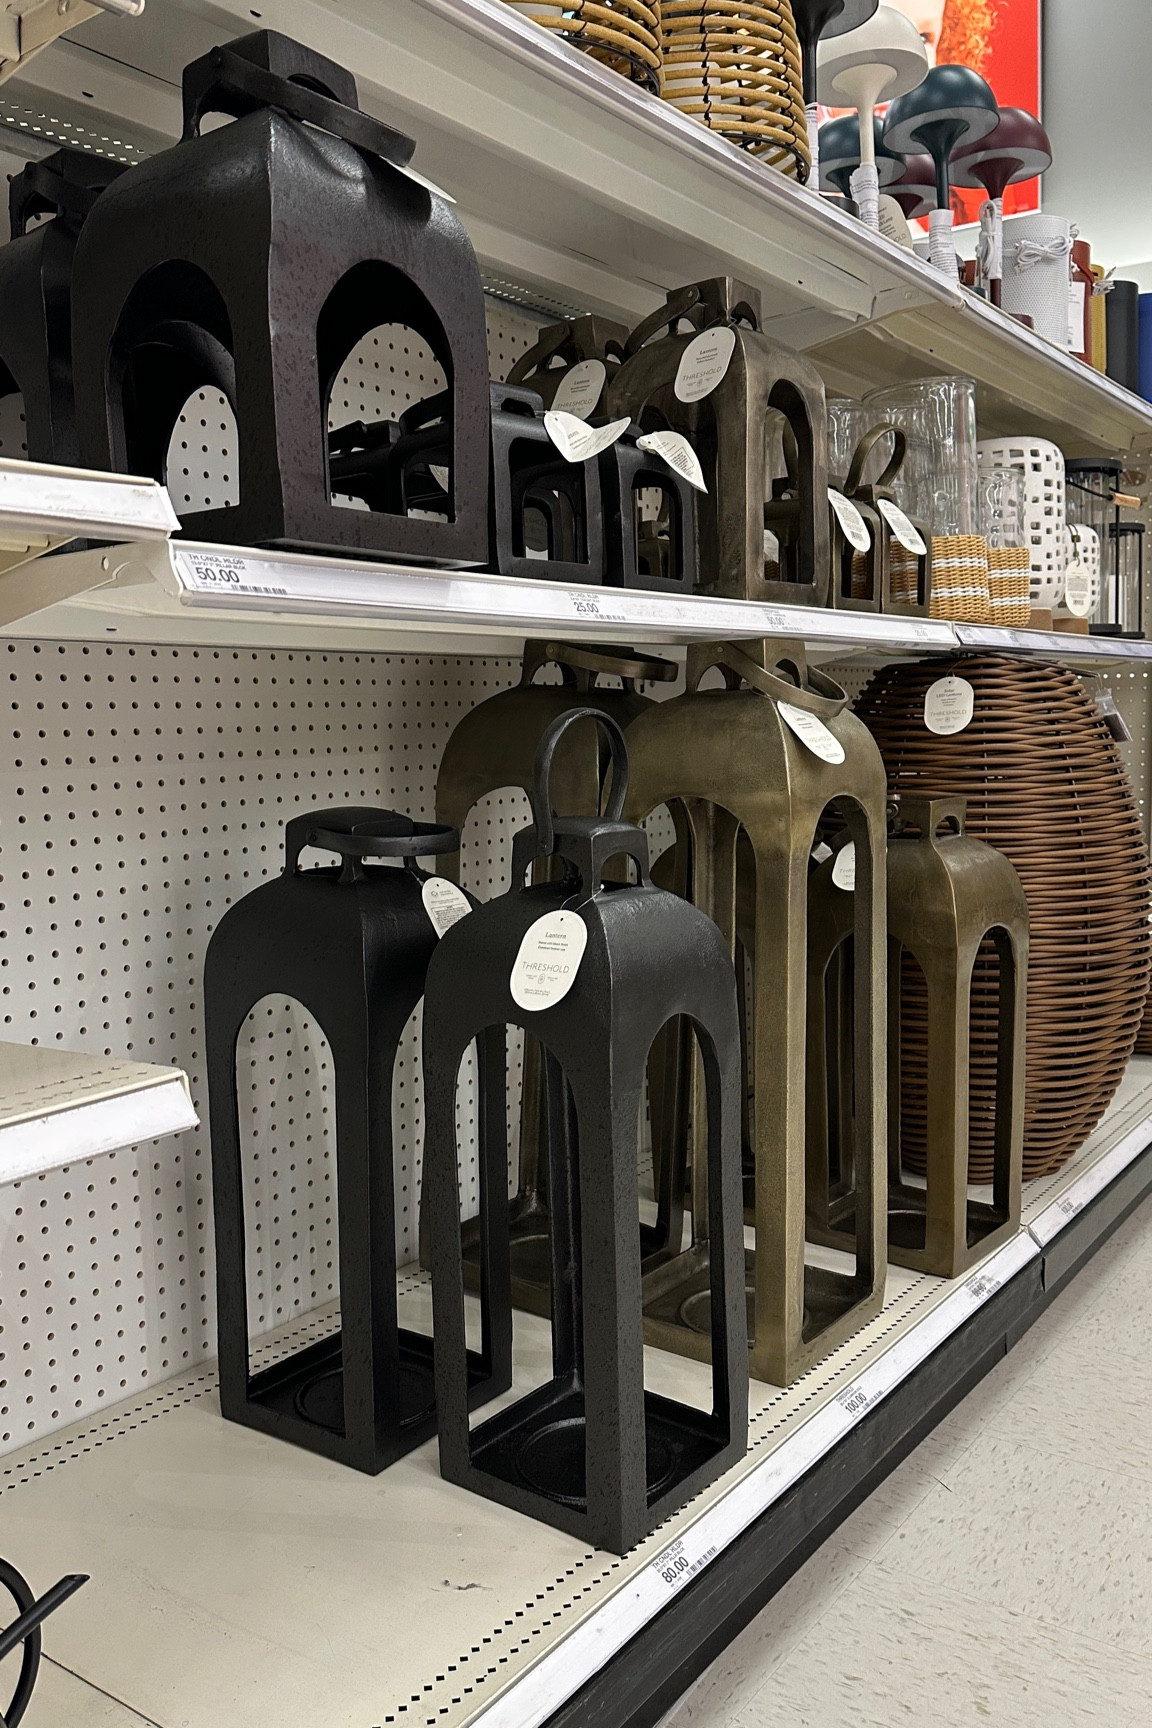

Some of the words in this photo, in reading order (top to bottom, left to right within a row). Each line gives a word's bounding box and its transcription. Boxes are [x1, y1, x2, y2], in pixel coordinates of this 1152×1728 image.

[682, 366, 722, 381] THRESHOLD
[195, 567, 240, 583] 50.00
[573, 601, 599, 613] 25.00
[930, 709, 967, 717] THRESHOLD
[545, 931, 567, 940] Lantern
[522, 961, 570, 974] THRESHOLD
[845, 1392, 867, 1414] 100.00
[661, 1556, 689, 1583] 80.00
